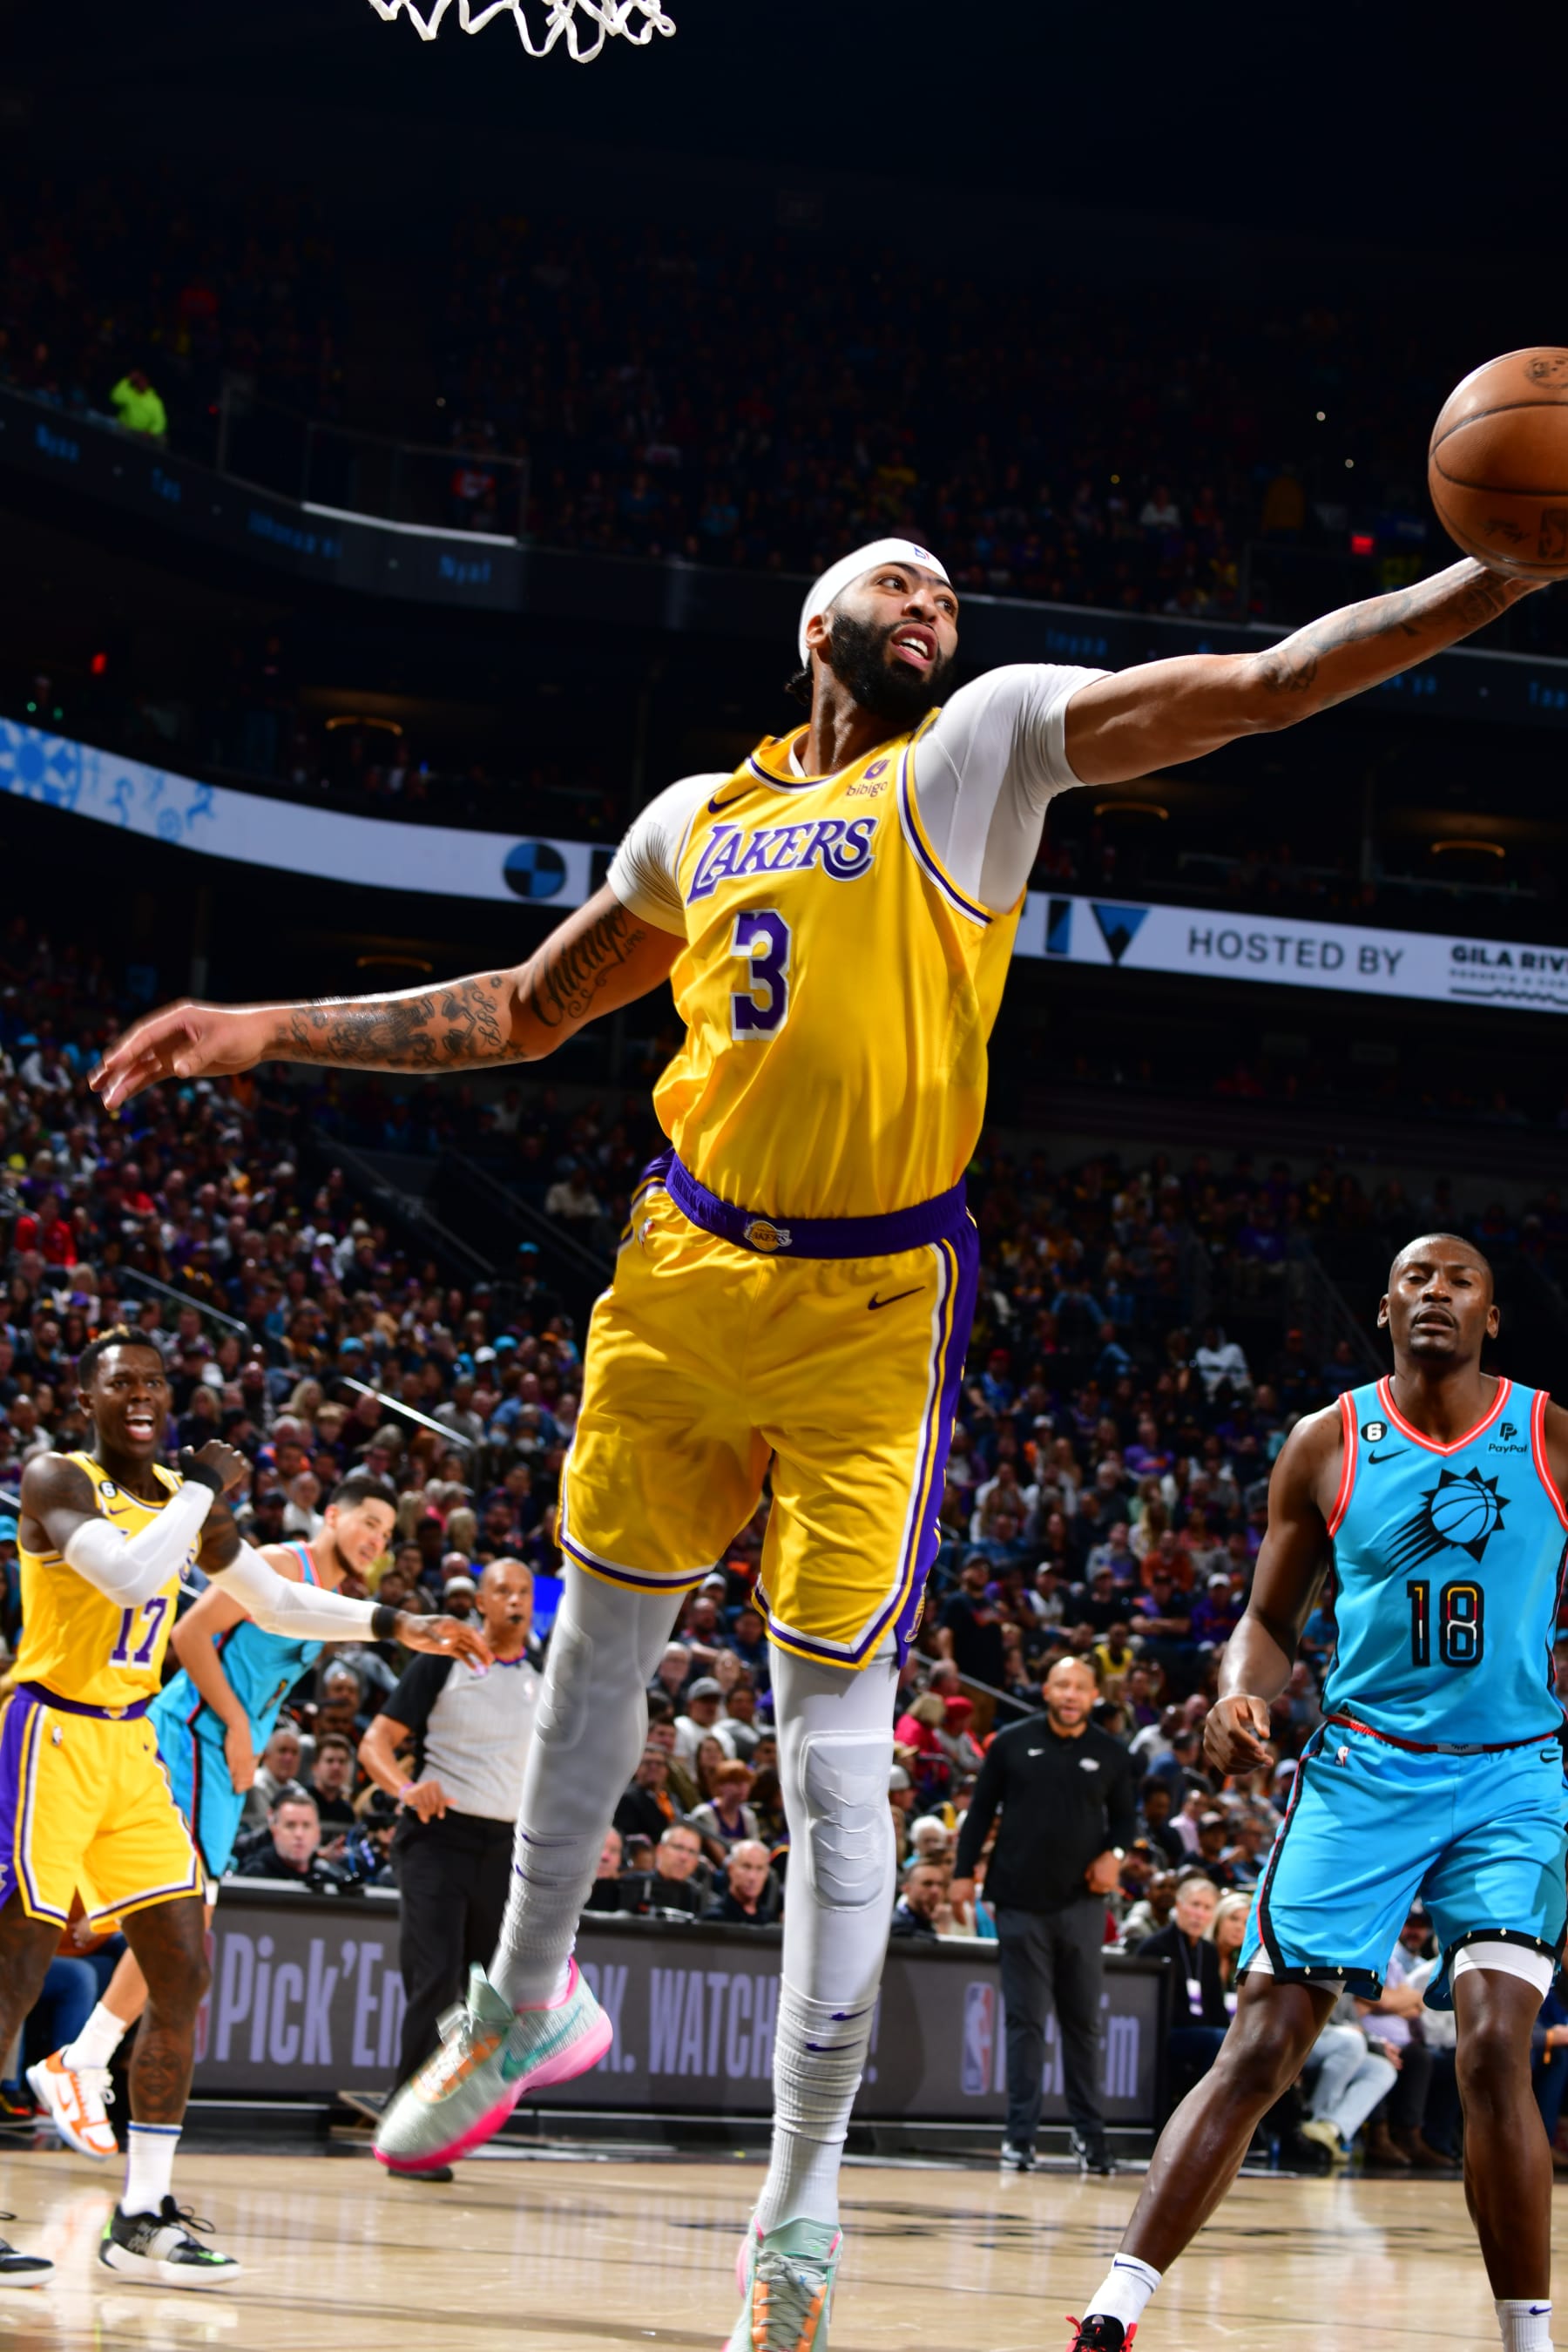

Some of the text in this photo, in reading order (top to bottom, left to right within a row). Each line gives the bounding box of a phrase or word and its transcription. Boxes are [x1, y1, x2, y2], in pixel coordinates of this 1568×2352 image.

[846, 781, 888, 798] bibigo
[686, 816, 879, 909] LAKERS
[1187, 925, 1344, 971] HOSTED
[1357, 944, 1403, 977] BY
[1451, 944, 1568, 973] GILA RIV
[730, 909, 791, 1041] 3
[1367, 1423, 1382, 1442] 6
[1488, 1443, 1528, 1454] PayPal
[101, 1481, 116, 1498] 6
[108, 1596, 168, 1670] 17
[1407, 1579, 1484, 1667] 18
